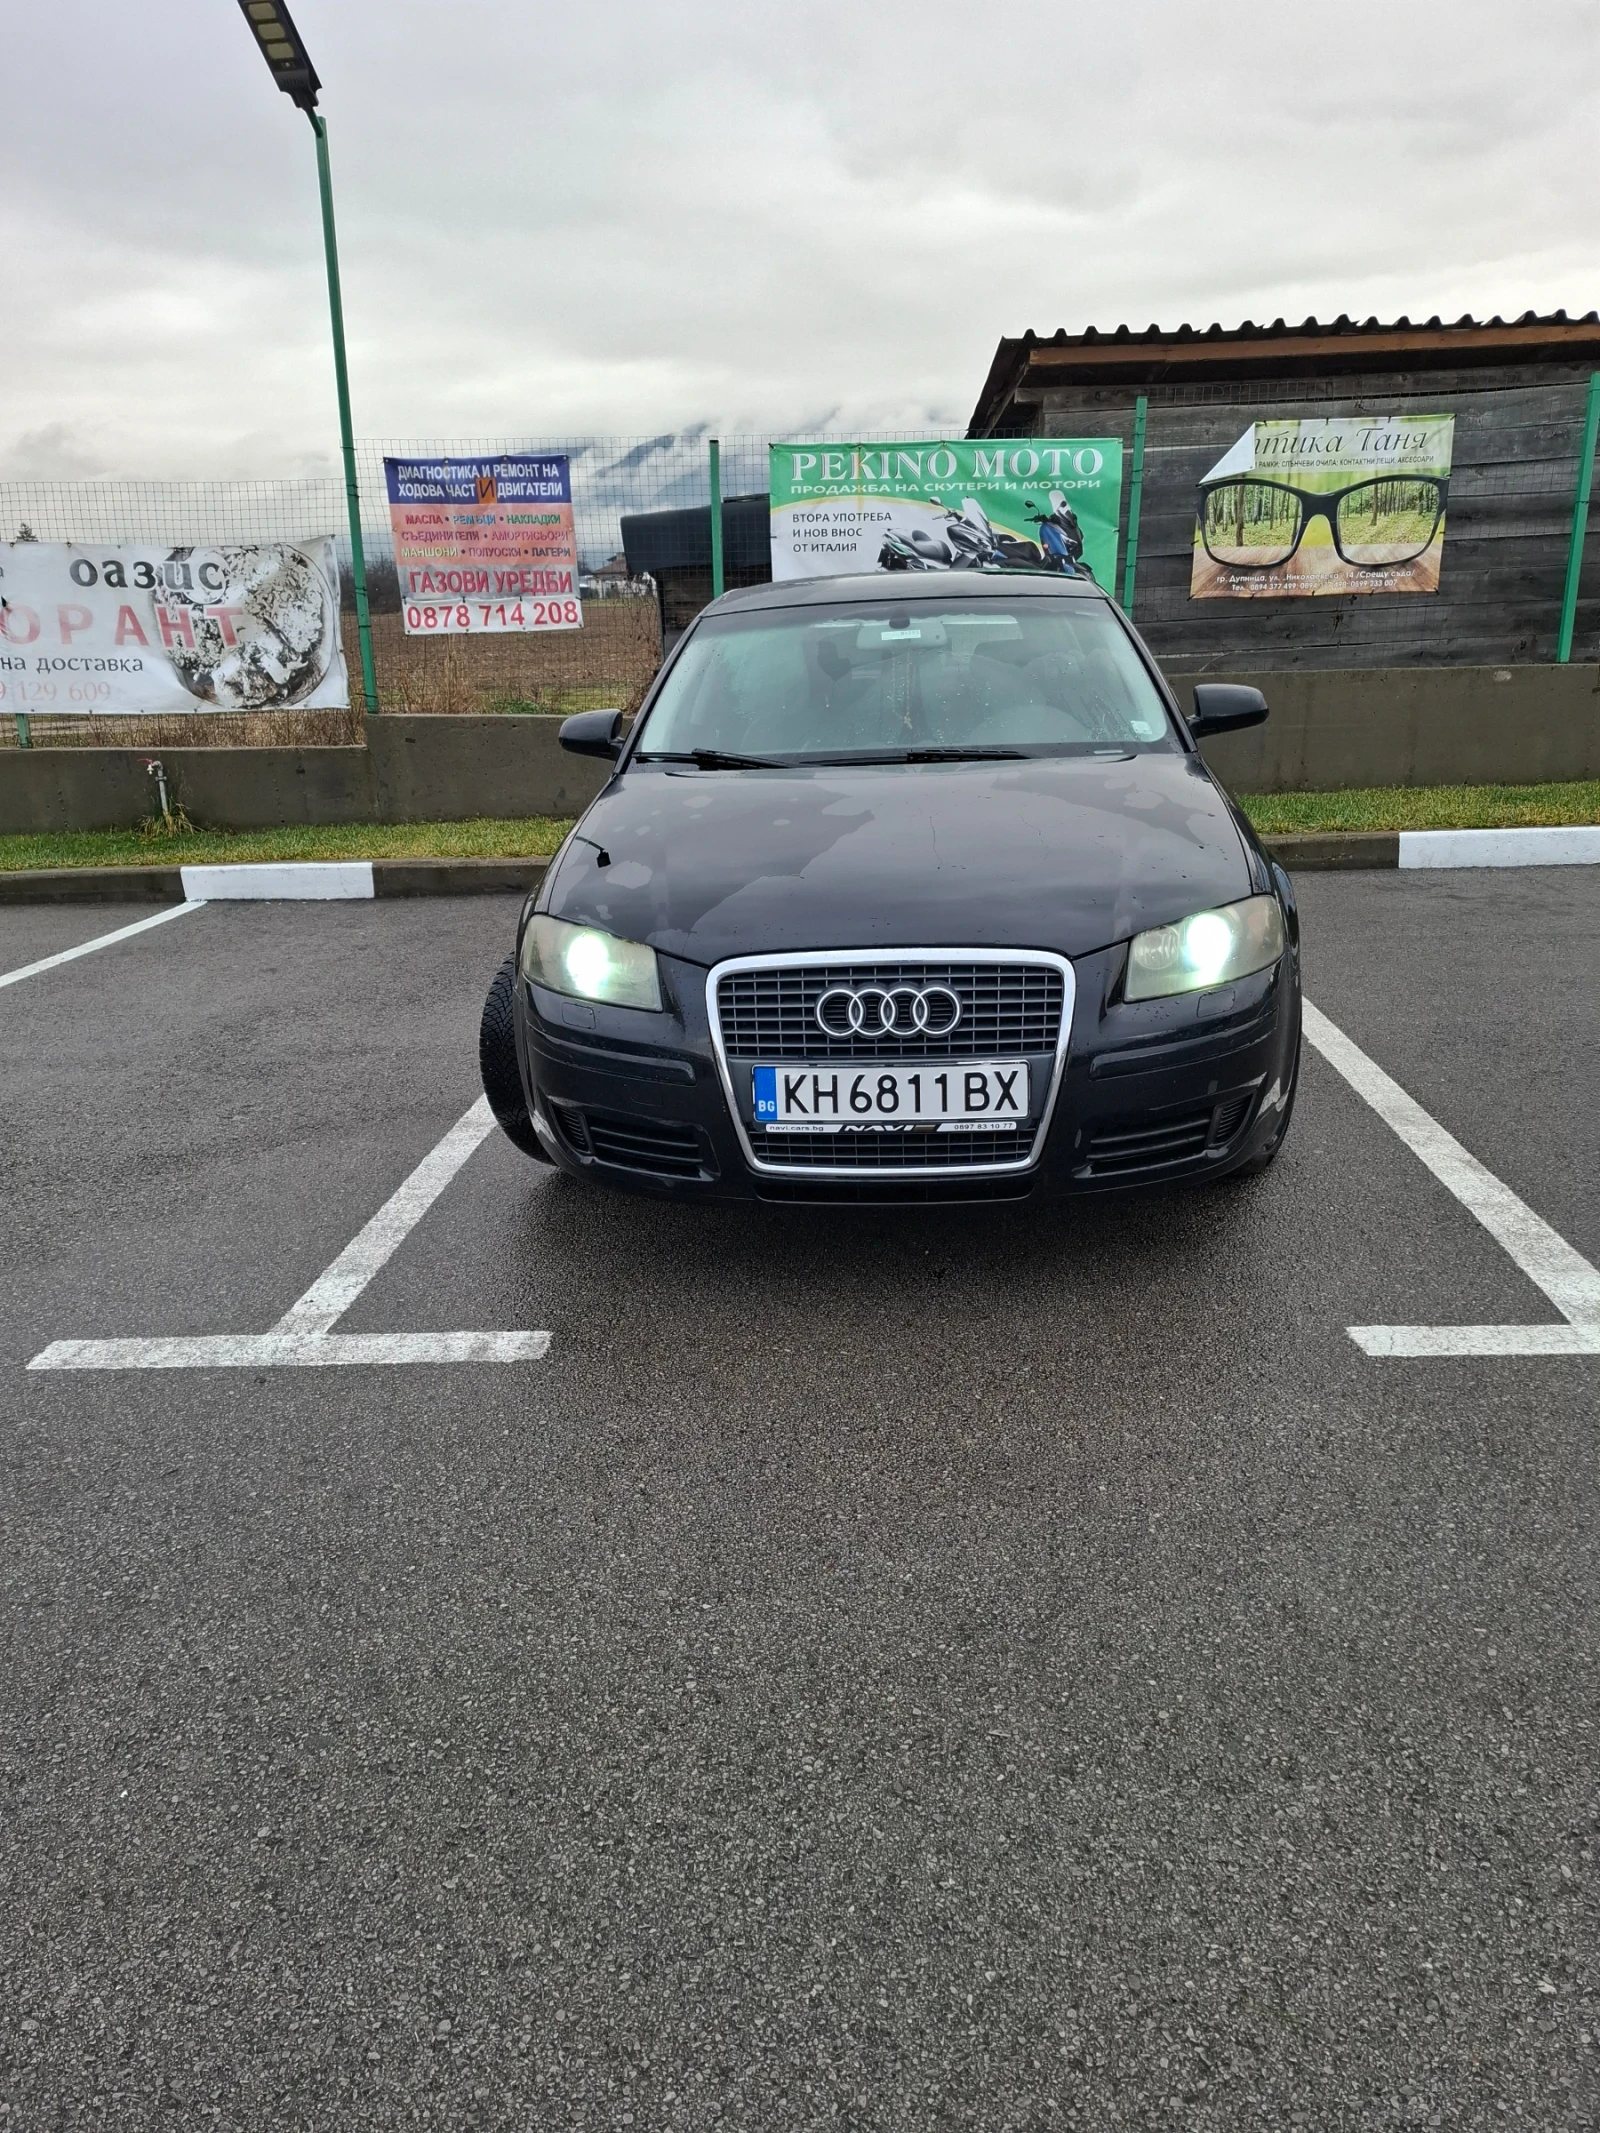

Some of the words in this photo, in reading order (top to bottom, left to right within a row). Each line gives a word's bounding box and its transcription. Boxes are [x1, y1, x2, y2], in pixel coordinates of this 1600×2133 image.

[1356, 427, 1428, 452] Таня
[791, 449, 957, 481] PEKINO
[972, 448, 1104, 479] MOTO
[1282, 460, 1315, 468] СЛЪНЧЕВИ
[1340, 457, 1375, 466] КОНТАКТНИ
[1397, 455, 1434, 464] АКСЕСОАРИ
[398, 465, 480, 481] ДИАГНОСТИКА
[482, 464, 491, 478] И
[493, 464, 539, 478] РЕМОНТ
[542, 463, 559, 477] НА
[398, 483, 444, 499] ХОДОВА
[498, 482, 563, 499] ДВИГАТЕЛИ
[790, 484, 888, 495] ПРОДАЖБА
[896, 483, 920, 493] НА
[924, 481, 1001, 492] СКУТЕРИ
[1005, 481, 1017, 491] И
[1021, 480, 1101, 491] МОТОРИ
[405, 514, 443, 525] МАСЛА
[453, 514, 496, 526] РЕМЪЦИ
[506, 514, 561, 526] НАКЛАДКИ
[792, 513, 830, 523] ВТОРА
[832, 512, 892, 523] УПОТРЕБА
[401, 531, 480, 543] СЪЕДИНИТЕЛИ
[491, 530, 569, 541] АМОРТИСЬОРИ
[793, 529, 801, 538] И
[803, 529, 829, 538] НОВ
[831, 528, 863, 538] ВНОС
[402, 547, 458, 558] МАНШОНИ
[469, 547, 522, 558] ПОЛУОСКИ
[531, 547, 571, 557] ЛАГЕРИ
[792, 543, 809, 553] ОТ
[811, 542, 857, 553] ИТАЛИЯ
[69, 558, 225, 591] оазис
[409, 571, 489, 594] ГАЗОВИ
[493, 571, 573, 596] УРЕДБИ
[1250, 583, 1268, 591] 0894
[1269, 582, 1282, 590] 377
[1370, 579, 1383, 587] 233
[1384, 578, 1397, 586] 007
[407, 605, 471, 629] 0878
[478, 603, 525, 626] 714
[532, 600, 578, 625] 208
[36, 655, 143, 674] доставка
[16, 680, 57, 701] 129
[68, 680, 111, 701] 609
[758, 1100, 776, 1112] BG
